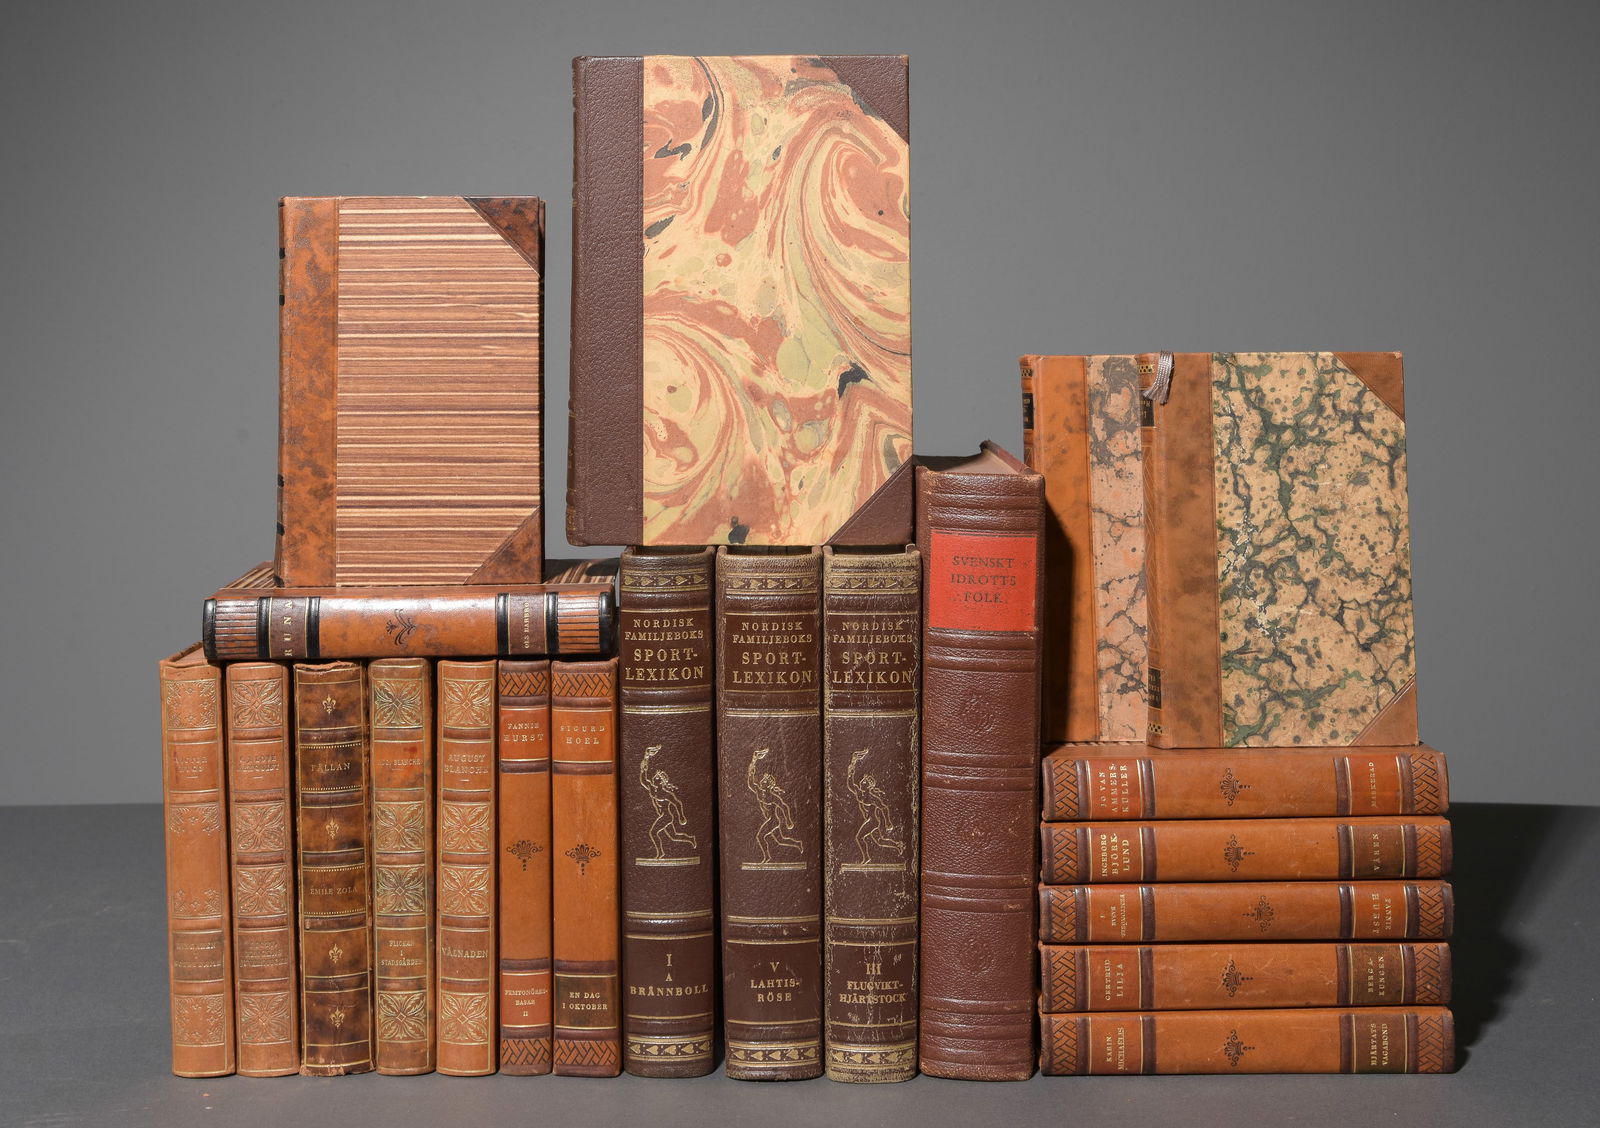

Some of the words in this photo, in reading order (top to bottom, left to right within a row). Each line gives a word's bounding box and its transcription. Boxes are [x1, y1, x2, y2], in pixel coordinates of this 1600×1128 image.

[952, 556, 1015, 568] SVENSKT
[951, 574, 1016, 586] IDROTTS
[283, 600, 293, 657] RUNA
[633, 618, 694, 628] NORDISK
[741, 622, 803, 631] NORDISK
[842, 621, 904, 631] NORDISK
[624, 630, 704, 641] FAMILJEBOKS
[732, 634, 812, 644] FAMILJEBOKS
[832, 634, 913, 644] FAMILJEBOKS
[633, 648, 698, 662] SPORT-
[741, 651, 806, 665] SPORT-
[842, 651, 906, 665] SPORT-
[625, 666, 704, 681] LEXIKON
[732, 670, 812, 684] LEXIKON
[832, 670, 912, 684] LEXIKON
[503, 733, 544, 742] HURST
[566, 736, 601, 745] HOEL
[447, 754, 486, 762] AUGUST
[1122, 840, 1130, 871] LUND
[666, 953, 673, 967] I
[770, 962, 780, 972] V
[865, 963, 882, 975] III
[665, 973, 673, 981] A
[750, 978, 800, 989] LAHTIS-
[757, 991, 792, 1002] RÖSE
[569, 1002, 608, 1010] OKTOBER
